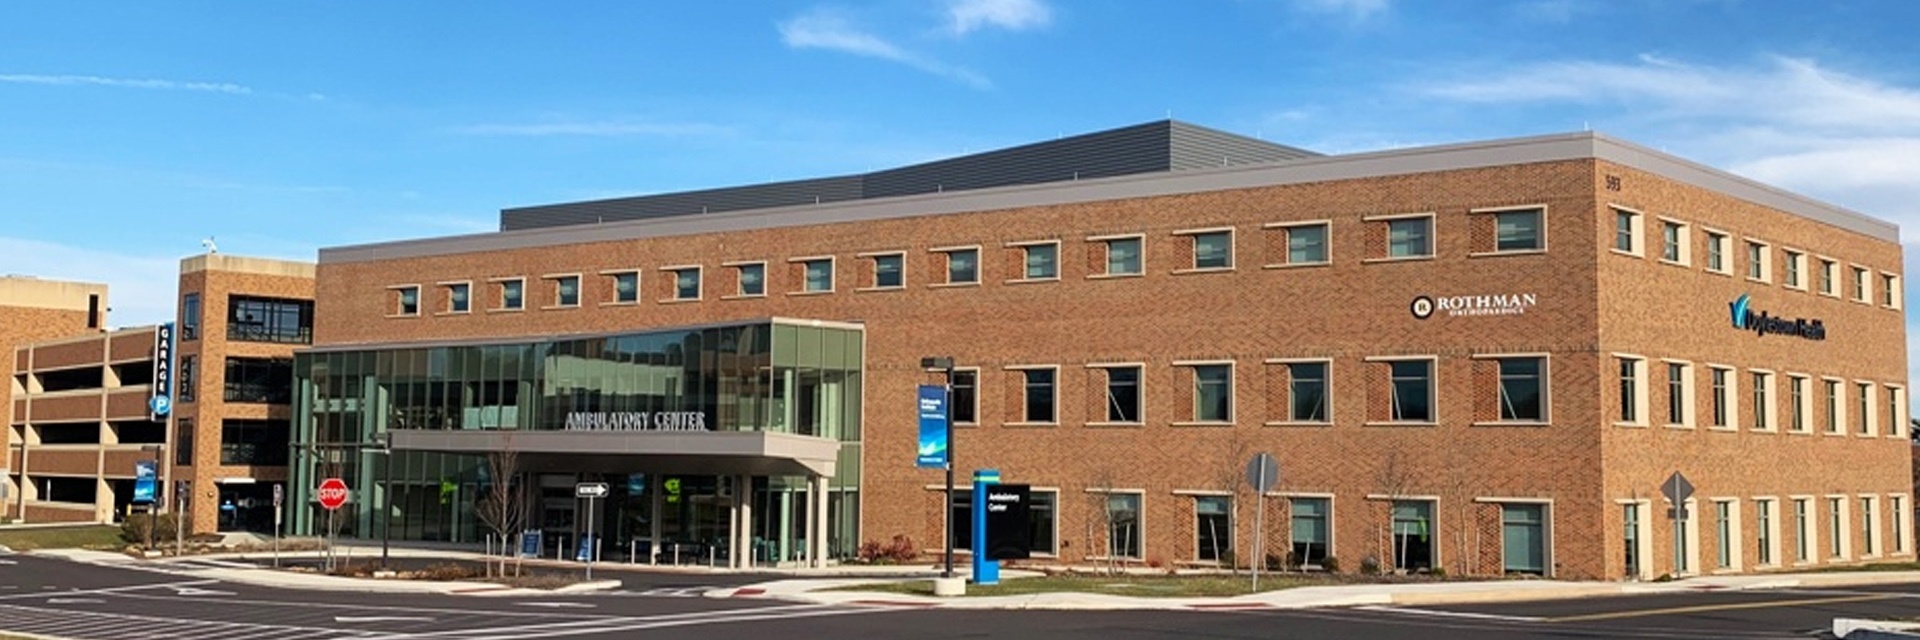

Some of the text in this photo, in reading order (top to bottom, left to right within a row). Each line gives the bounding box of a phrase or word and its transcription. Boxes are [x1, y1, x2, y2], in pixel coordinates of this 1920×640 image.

[1605, 174, 1621, 191] 593
[1438, 294, 1536, 310] ROTHMAN
[1449, 307, 1524, 317] ORTHOPAEDICS
[160, 328, 169, 392] GARAGE
[156, 399, 167, 412] P
[565, 411, 706, 429] AMBULATORY CENTER
[320, 488, 345, 500] STOP
[988, 492, 1020, 503] Ambulatory
[988, 503, 1008, 512] Center
